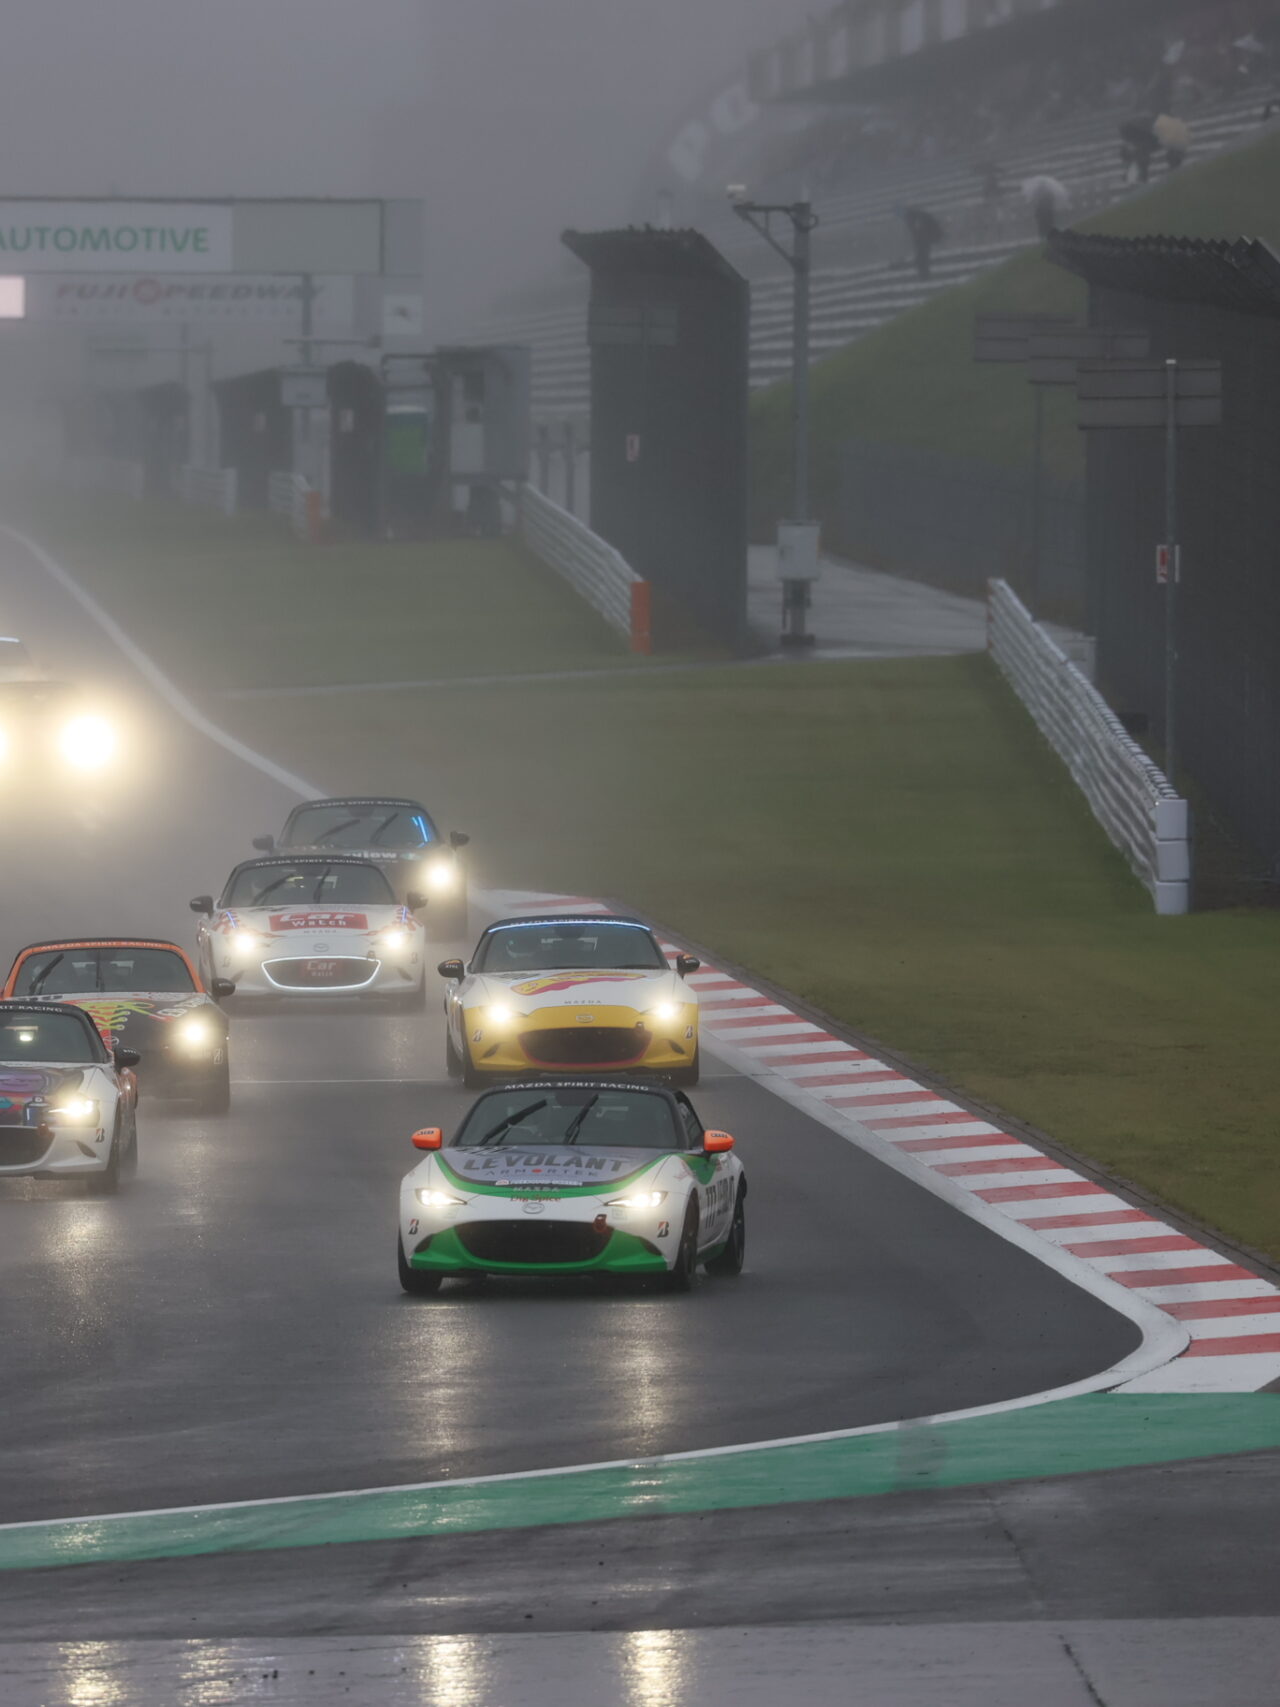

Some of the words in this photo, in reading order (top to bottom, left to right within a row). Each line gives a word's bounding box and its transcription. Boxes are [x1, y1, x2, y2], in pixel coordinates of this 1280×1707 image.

[56, 284, 128, 300] FUJI
[279, 913, 355, 922] Car
[291, 919, 347, 928] Watch
[18, 1004, 64, 1014] RACING
[504, 1082, 552, 1090] MAZDA
[556, 1080, 596, 1088] SPIRIT
[600, 1081, 649, 1092] RACING
